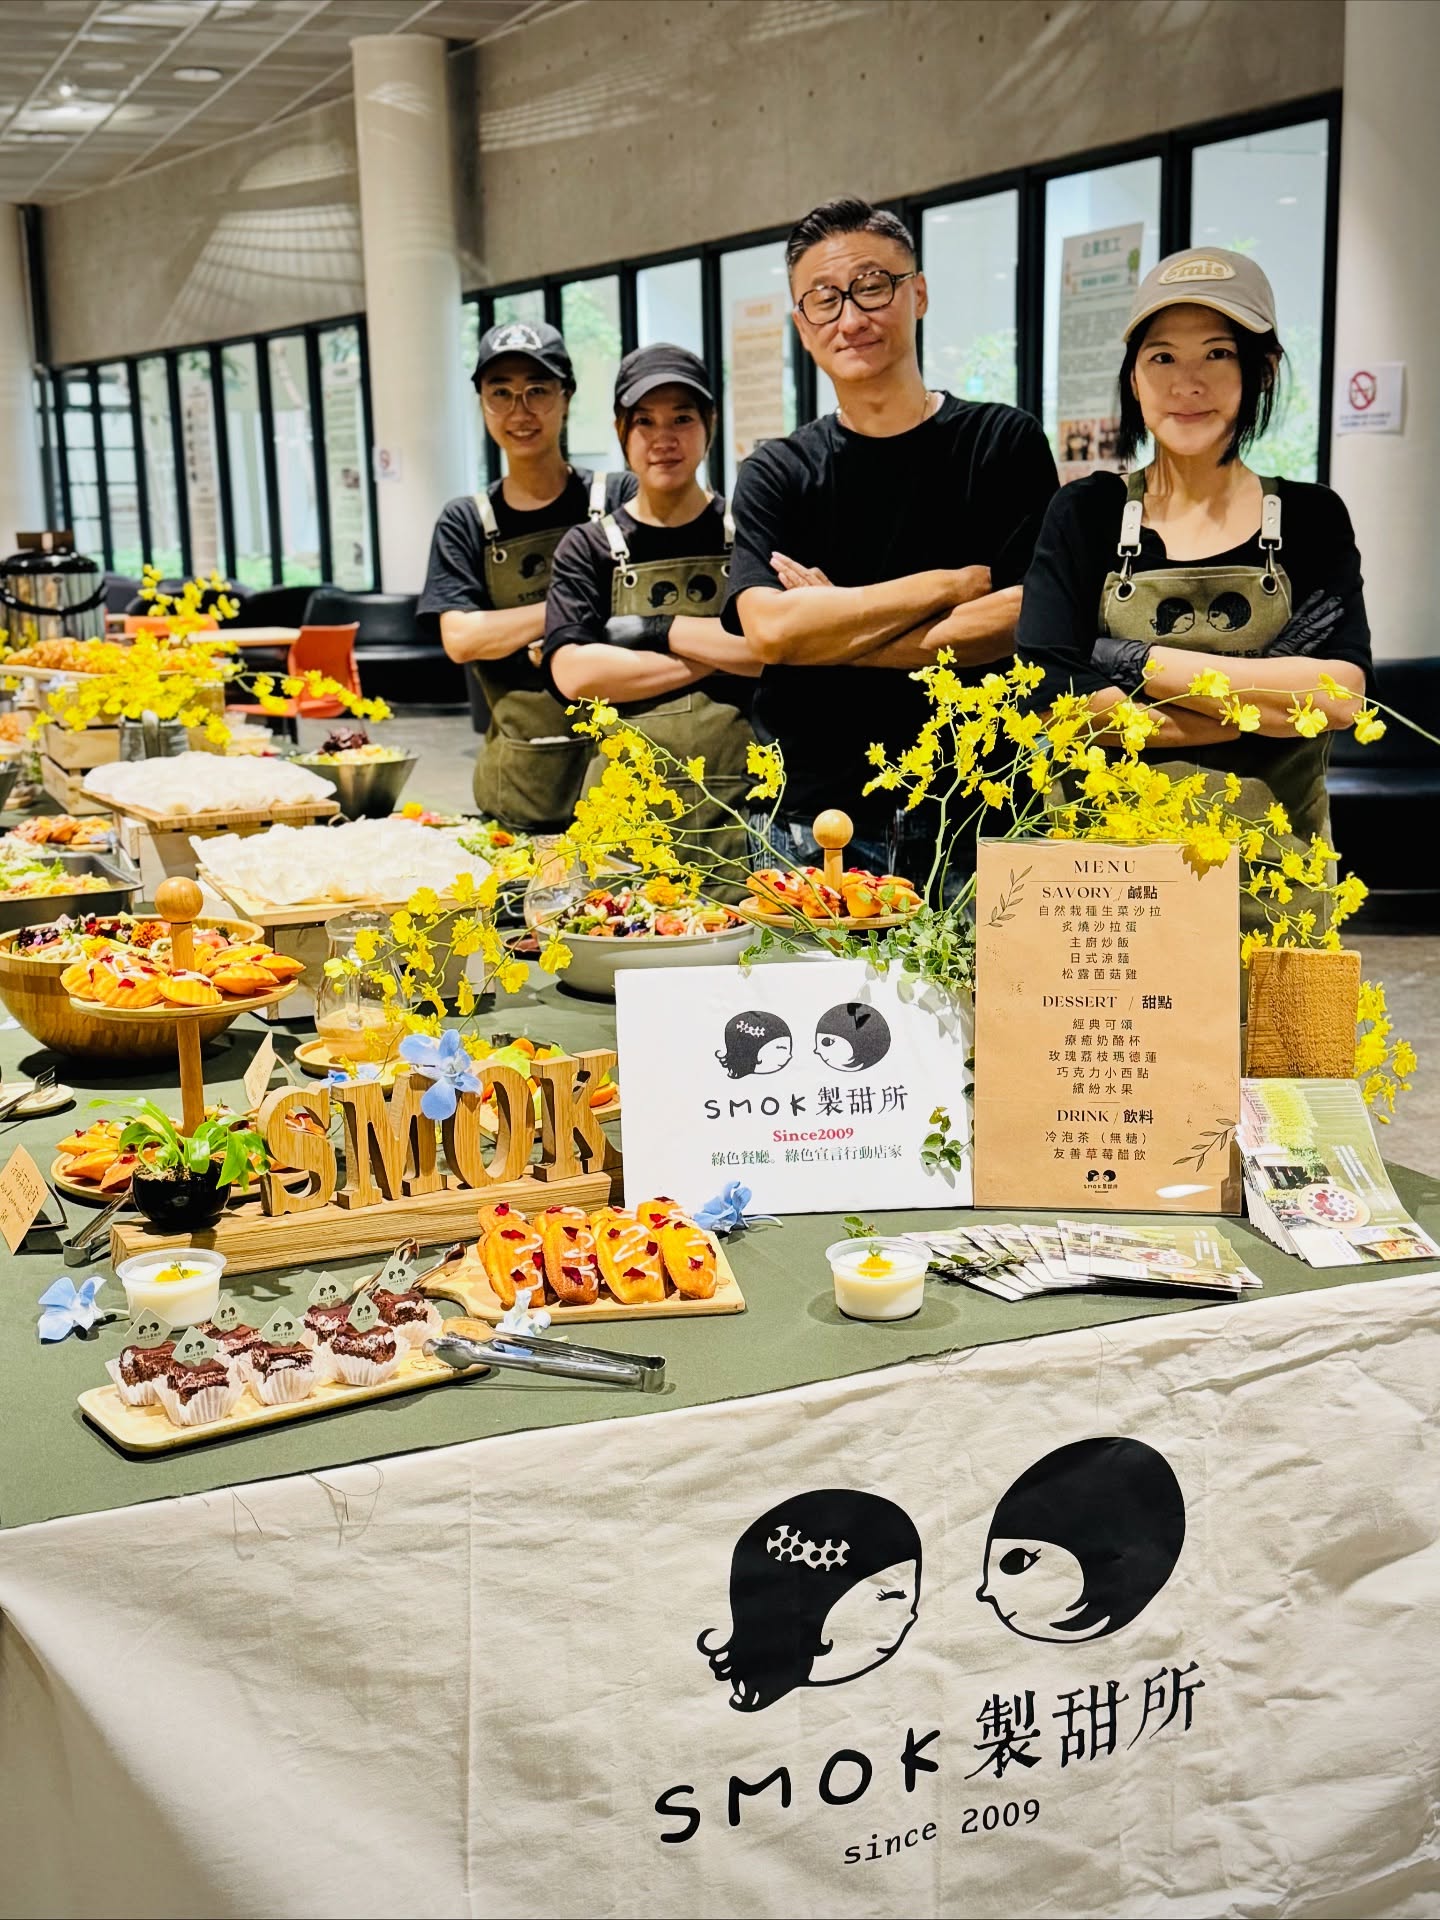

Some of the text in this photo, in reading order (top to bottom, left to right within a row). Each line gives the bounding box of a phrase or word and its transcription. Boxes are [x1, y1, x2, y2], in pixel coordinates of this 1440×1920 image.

[1074, 860, 1136, 874] MENU
[1042, 886, 1113, 899] SAVORY
[1127, 885, 1159, 900] 鹹點
[1039, 905, 1162, 917] 自然栽種生菜沙拉
[1061, 920, 1137, 933] 炙燒沙拉蛋
[1069, 936, 1129, 949] 主廚炒飯
[1061, 968, 1138, 980] 松露菌菇雞
[1042, 995, 1118, 1008] DESSERT
[1141, 994, 1173, 1010] 甜點
[1072, 1018, 1133, 1031] 經典可頌
[1064, 1034, 1141, 1047] 療癒奶酪杯
[1056, 1066, 1149, 1079] 巧克力小西點
[1072, 1082, 1133, 1095] 繽紛水果
[704, 1084, 909, 1120] SMOK 製甜所
[1056, 1109, 1109, 1123] DRINK
[1122, 1108, 1155, 1124] 飲料
[257, 1049, 617, 1217] SMOK
[772, 1127, 855, 1143] Since2009
[1053, 1147, 1146, 1161] 友善草莓醋飲
[653, 1660, 1206, 1845] SMOK 製甜所
[843, 1799, 1041, 1865] since 2009
